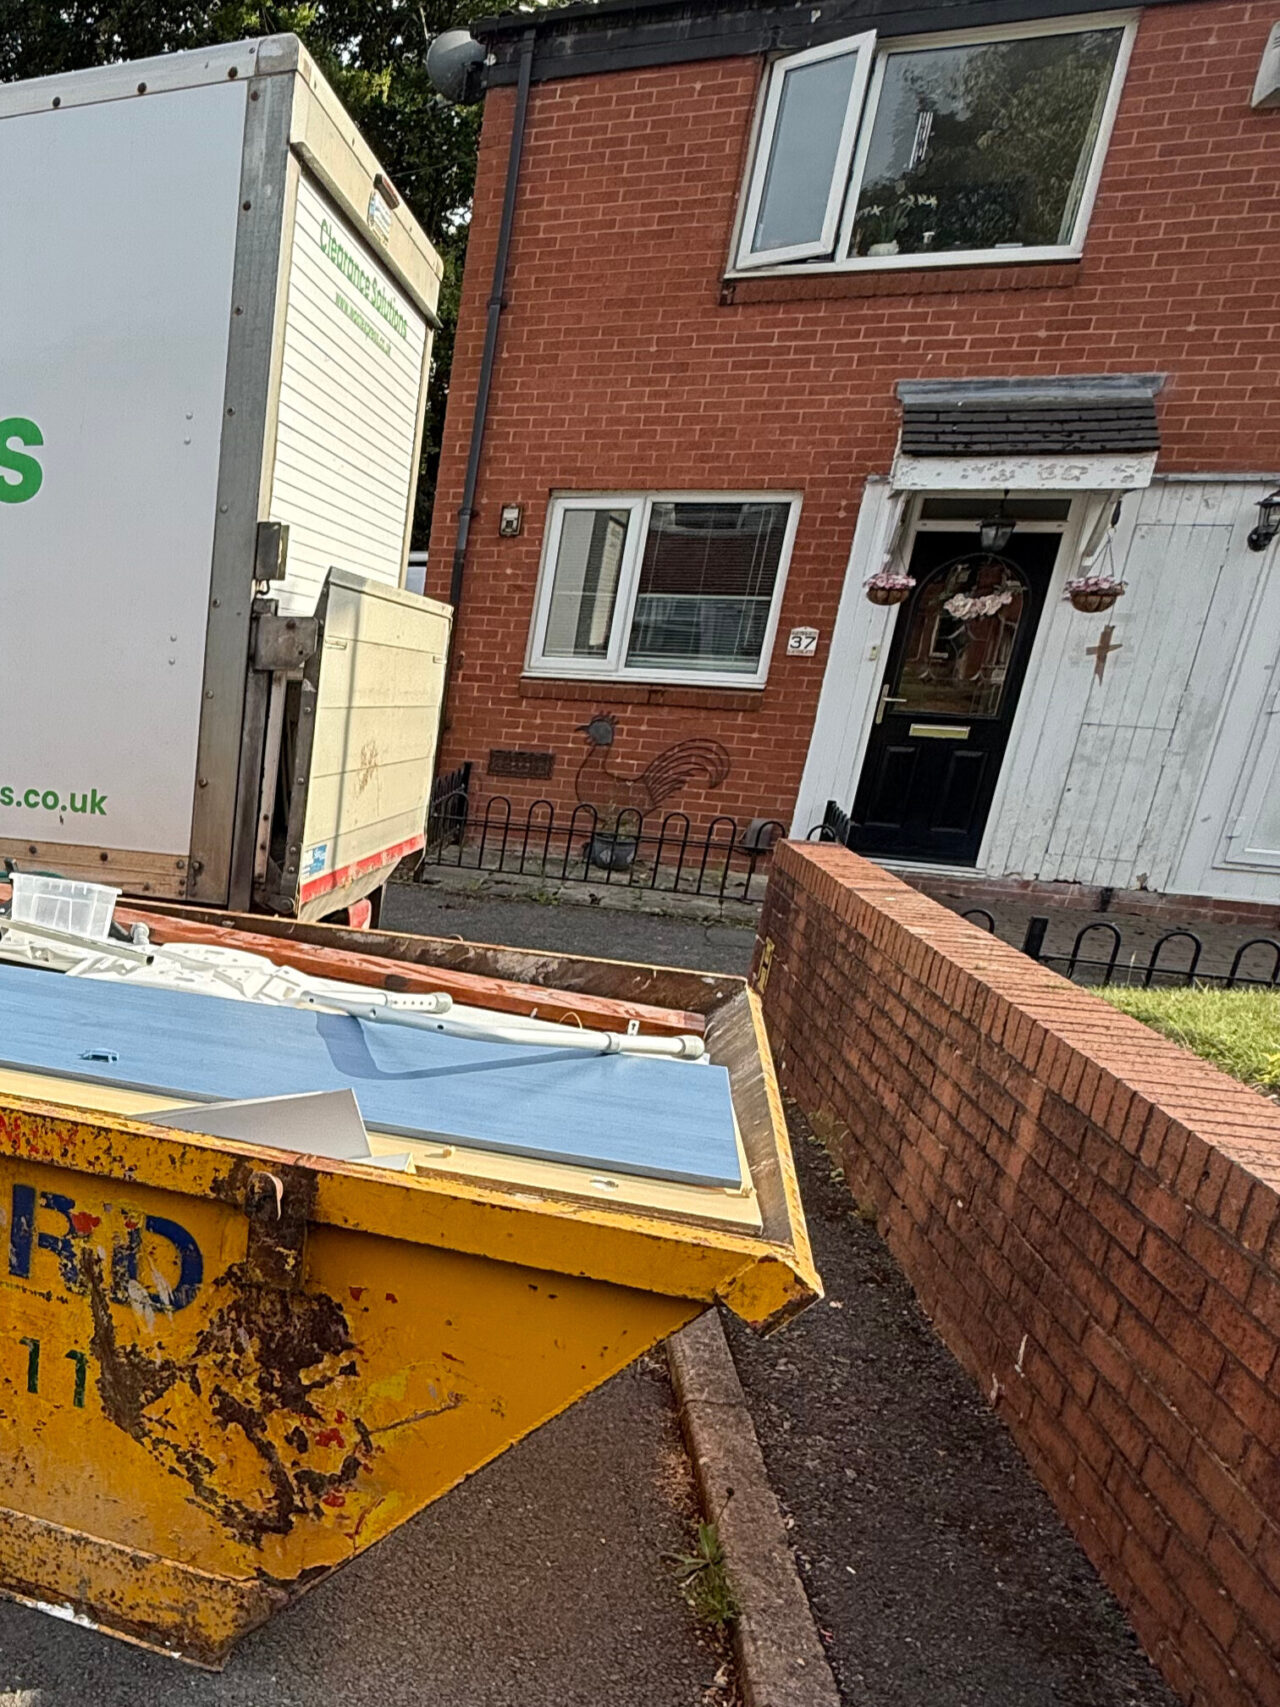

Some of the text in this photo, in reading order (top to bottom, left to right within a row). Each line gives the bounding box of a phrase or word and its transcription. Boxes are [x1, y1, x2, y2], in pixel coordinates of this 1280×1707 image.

[320, 218, 371, 301] Clearance
[371, 277, 408, 340] Solutions
[790, 635, 817, 650] 37
